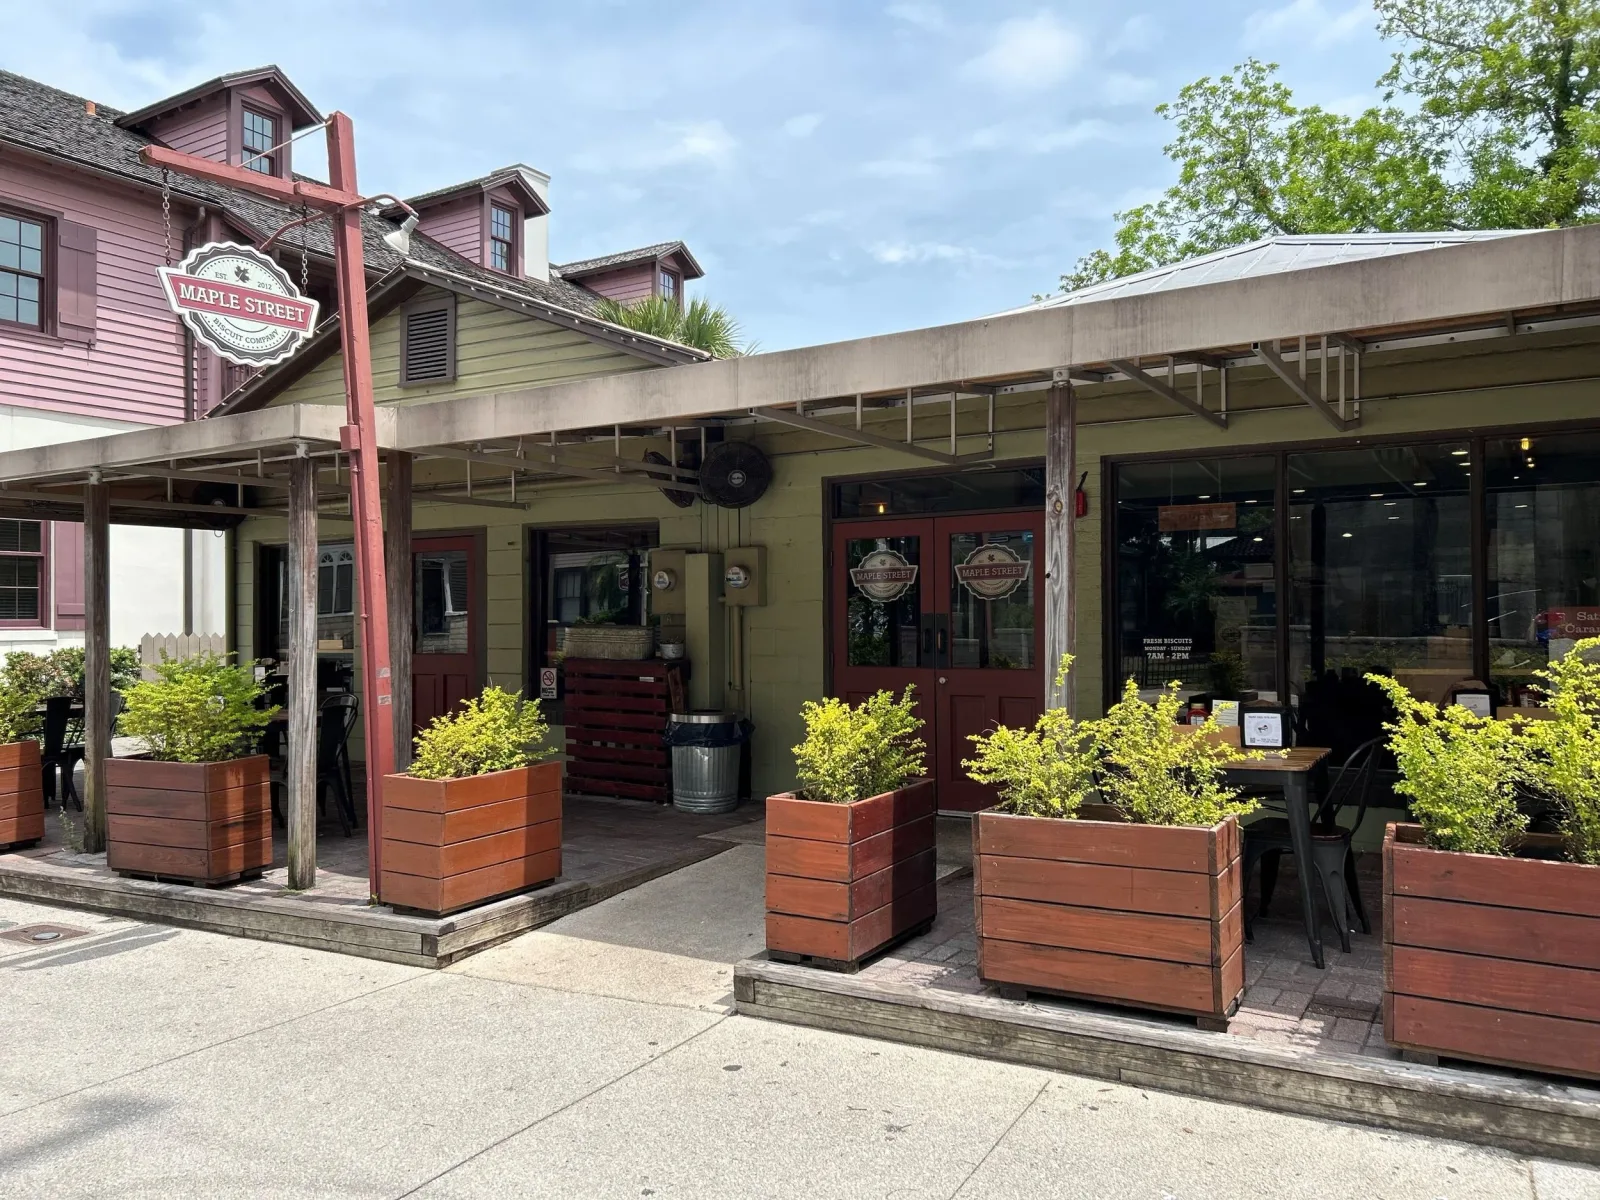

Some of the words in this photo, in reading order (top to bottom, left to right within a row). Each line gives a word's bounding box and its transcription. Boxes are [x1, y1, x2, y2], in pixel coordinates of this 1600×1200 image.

[257, 281, 273, 291] 2012
[179, 282, 241, 310] MAPLE
[245, 297, 305, 323] STREET
[213, 318, 243, 342] BISCUIT
[245, 329, 279, 345] COMPANY
[857, 572, 882, 580] MAPLE
[883, 570, 911, 579] STREET
[962, 568, 990, 577] MAPLE
[991, 566, 1023, 576] STREET
[1577, 611, 1600, 621] Sat
[1147, 652, 1165, 660] 7AM
[1171, 652, 1190, 660] 2PM
